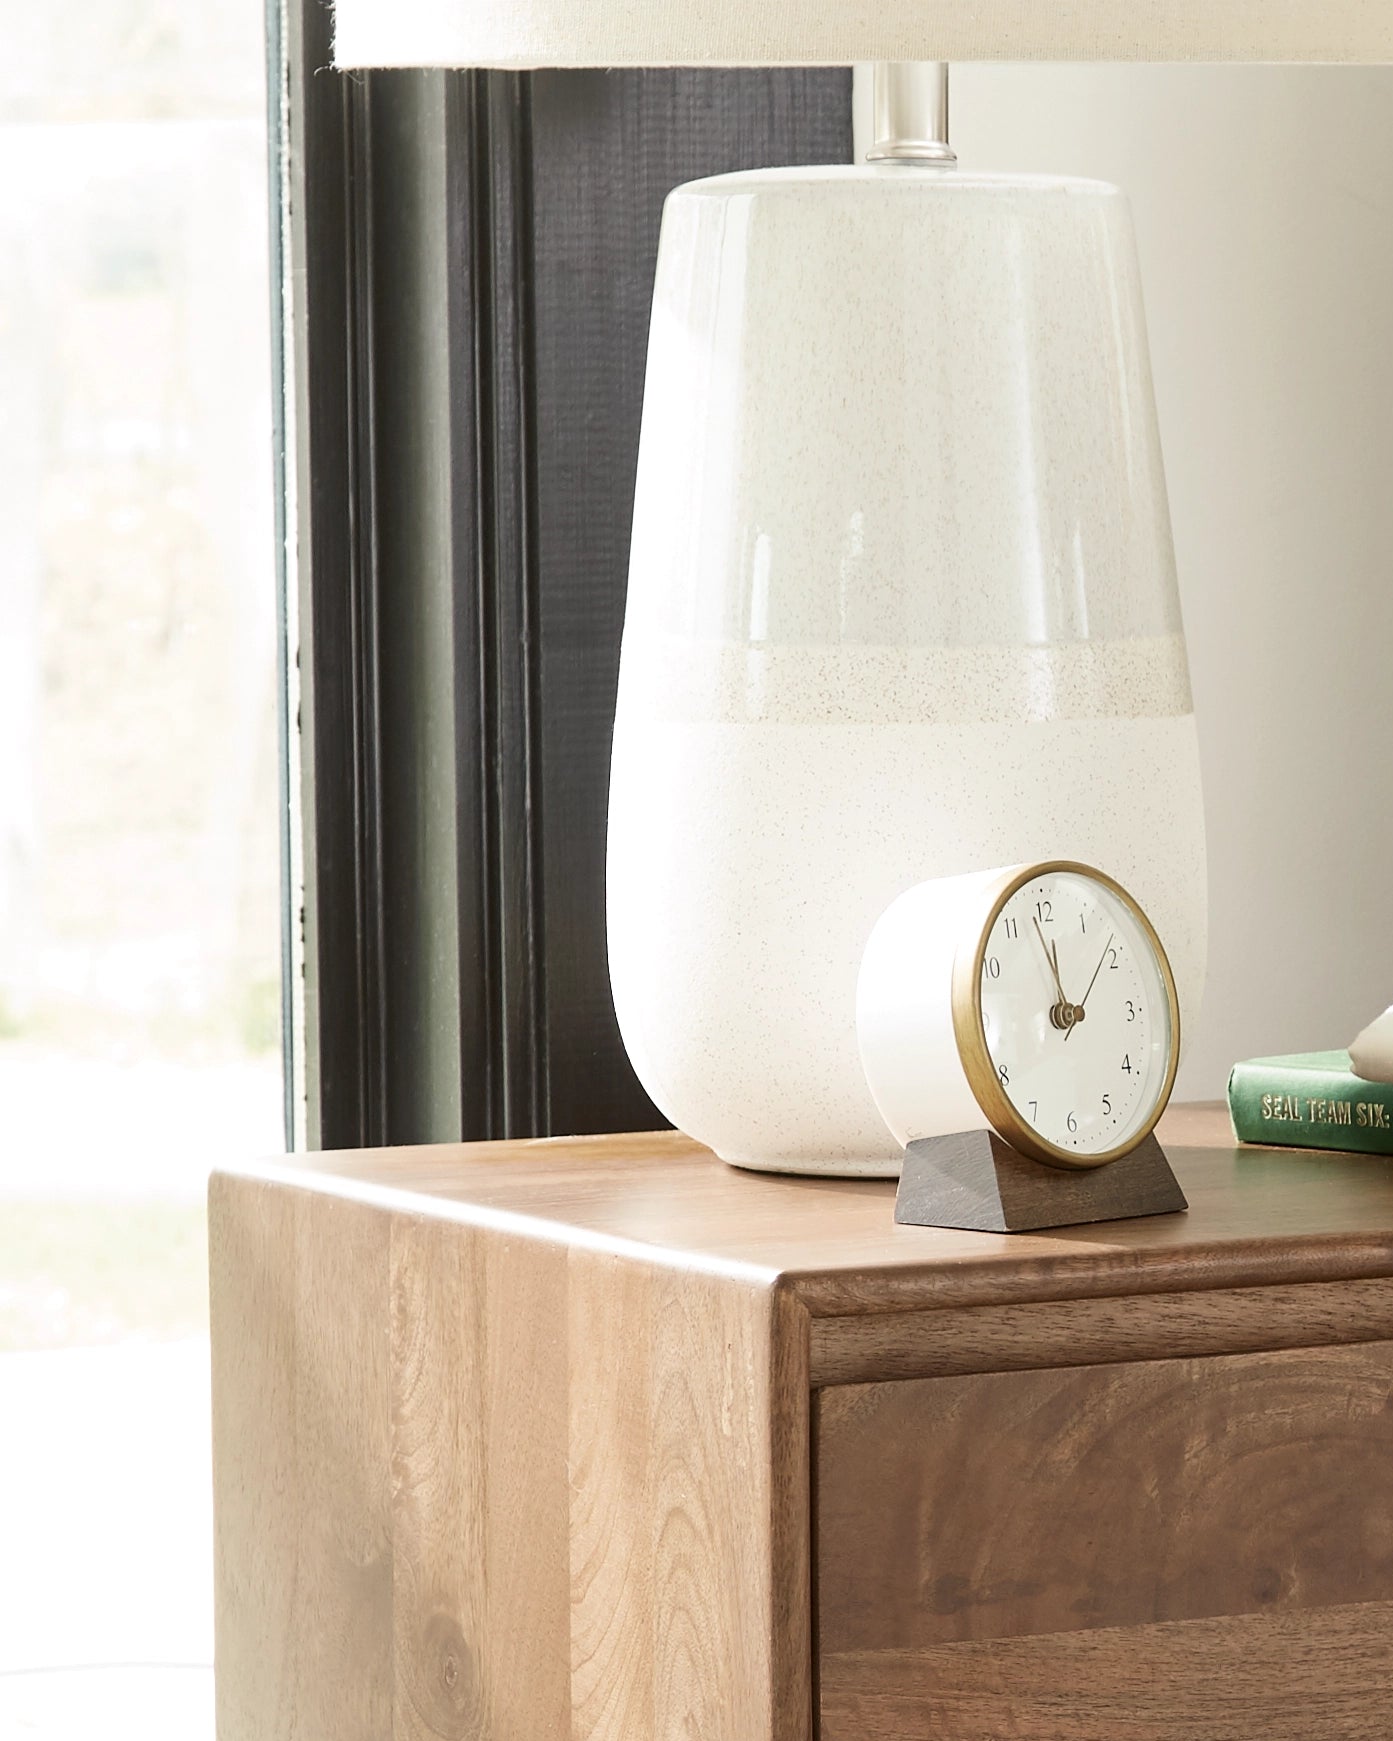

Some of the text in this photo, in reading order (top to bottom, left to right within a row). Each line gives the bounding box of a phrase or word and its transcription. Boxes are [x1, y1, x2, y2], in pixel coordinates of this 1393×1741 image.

[1035, 901, 1054, 923] 12
[1003, 917, 1018, 939] 11
[1079, 913, 1086, 934] 1
[983, 956, 1001, 979] 10
[1109, 948, 1119, 970] 2
[1125, 1000, 1136, 1022] 3
[1121, 1053, 1132, 1075] 4
[999, 1064, 1010, 1087] 8
[1028, 1100, 1039, 1122] 7
[1101, 1093, 1112, 1116] 5
[1262, 1094, 1302, 1121] SEAL
[1306, 1097, 1352, 1125] TEAM
[1356, 1102, 1390, 1129] SIX:
[1066, 1111, 1078, 1133] 6
